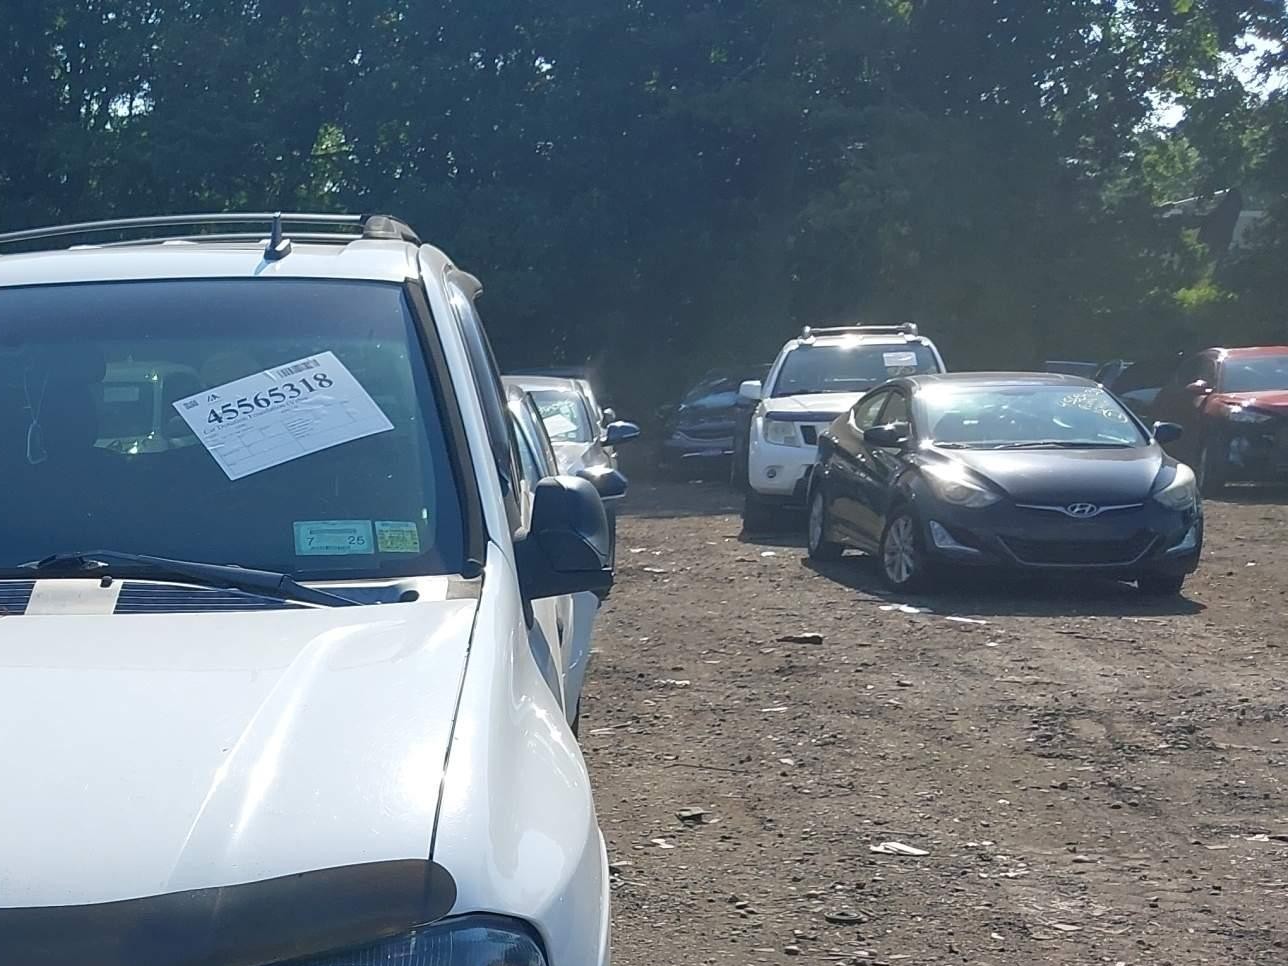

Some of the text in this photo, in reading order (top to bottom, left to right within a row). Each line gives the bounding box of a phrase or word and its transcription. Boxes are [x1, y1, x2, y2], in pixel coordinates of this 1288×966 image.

[207, 373, 334, 424] 45565318
[306, 535, 365, 546] 7 25
